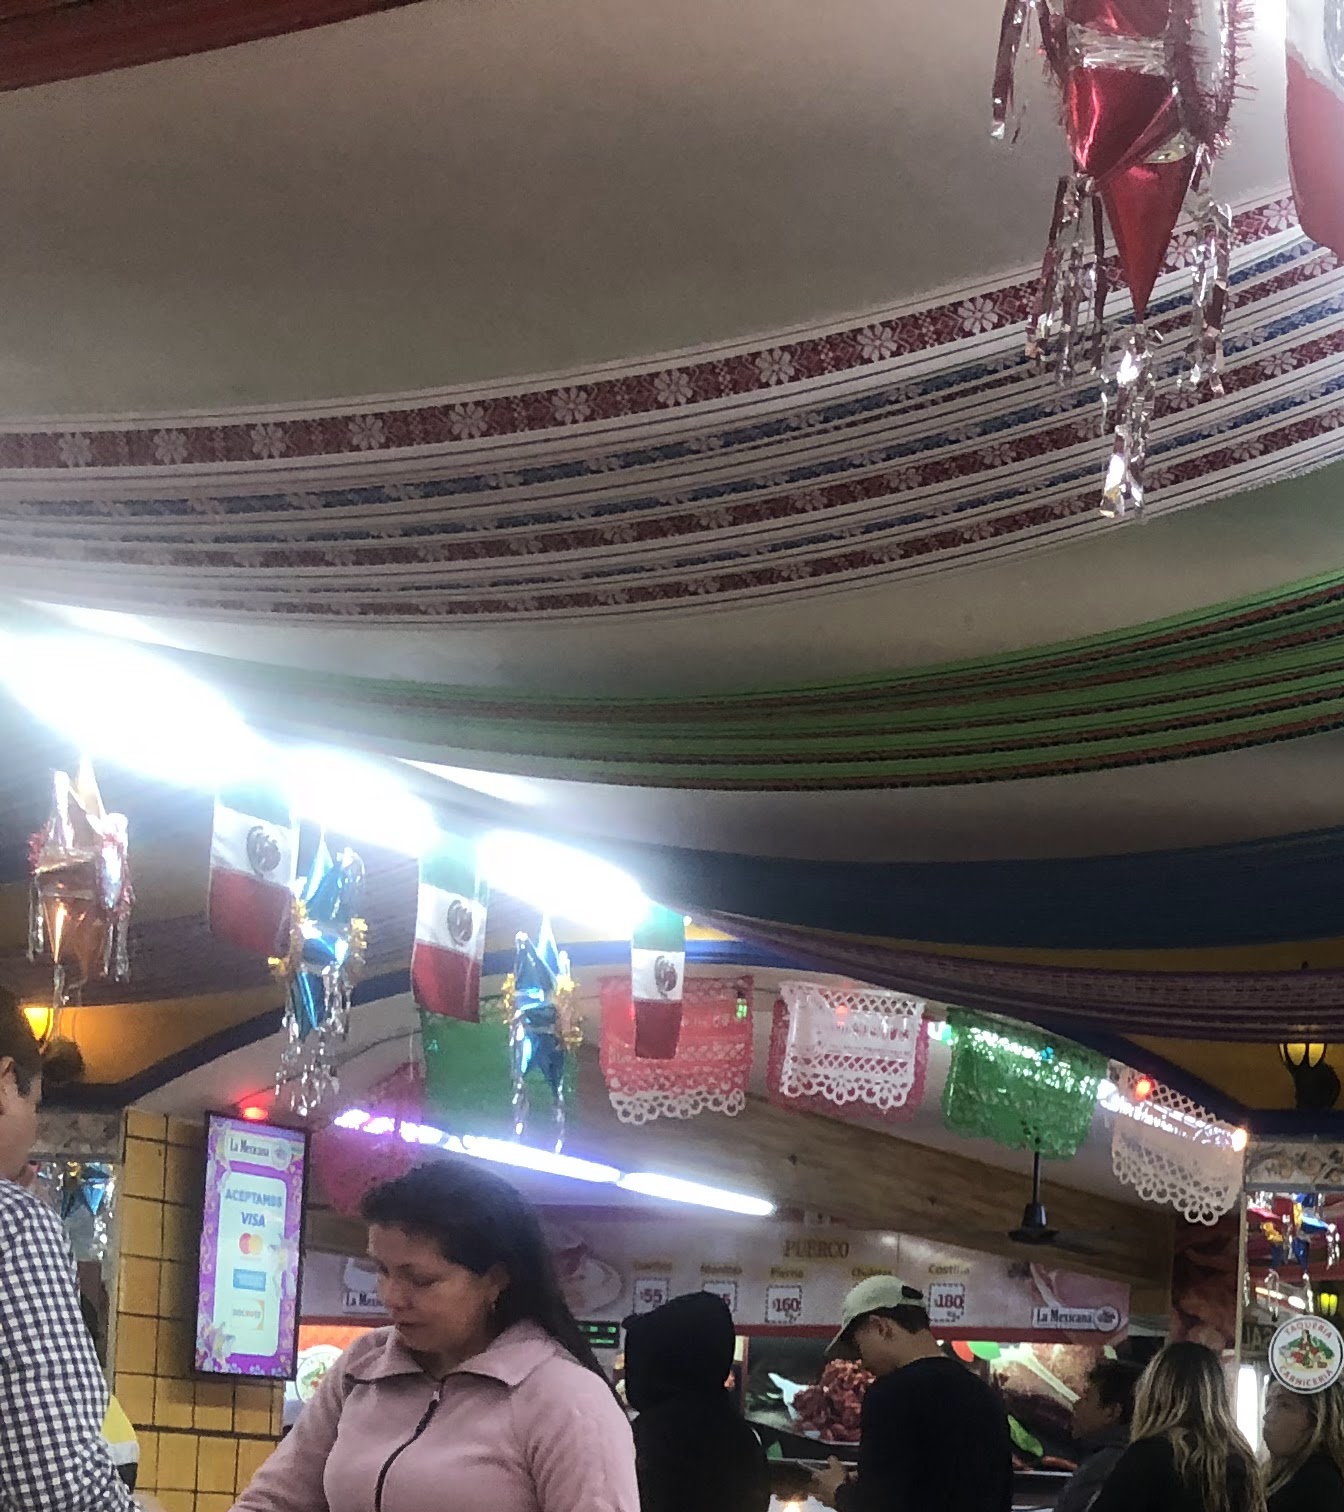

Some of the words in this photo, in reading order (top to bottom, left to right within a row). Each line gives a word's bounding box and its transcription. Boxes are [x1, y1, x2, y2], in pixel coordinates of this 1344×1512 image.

[230, 1138, 238, 1152] La
[225, 1188, 283, 1208] ACEPTAMOS
[241, 1211, 266, 1228] VISA
[783, 1239, 850, 1259] PUERCO
[1037, 1309, 1048, 1322] La
[1050, 1309, 1092, 1323] Mexicana
[1285, 1321, 1333, 1339] TAQUERIA
[1279, 1366, 1333, 1387] CARNICERIA
